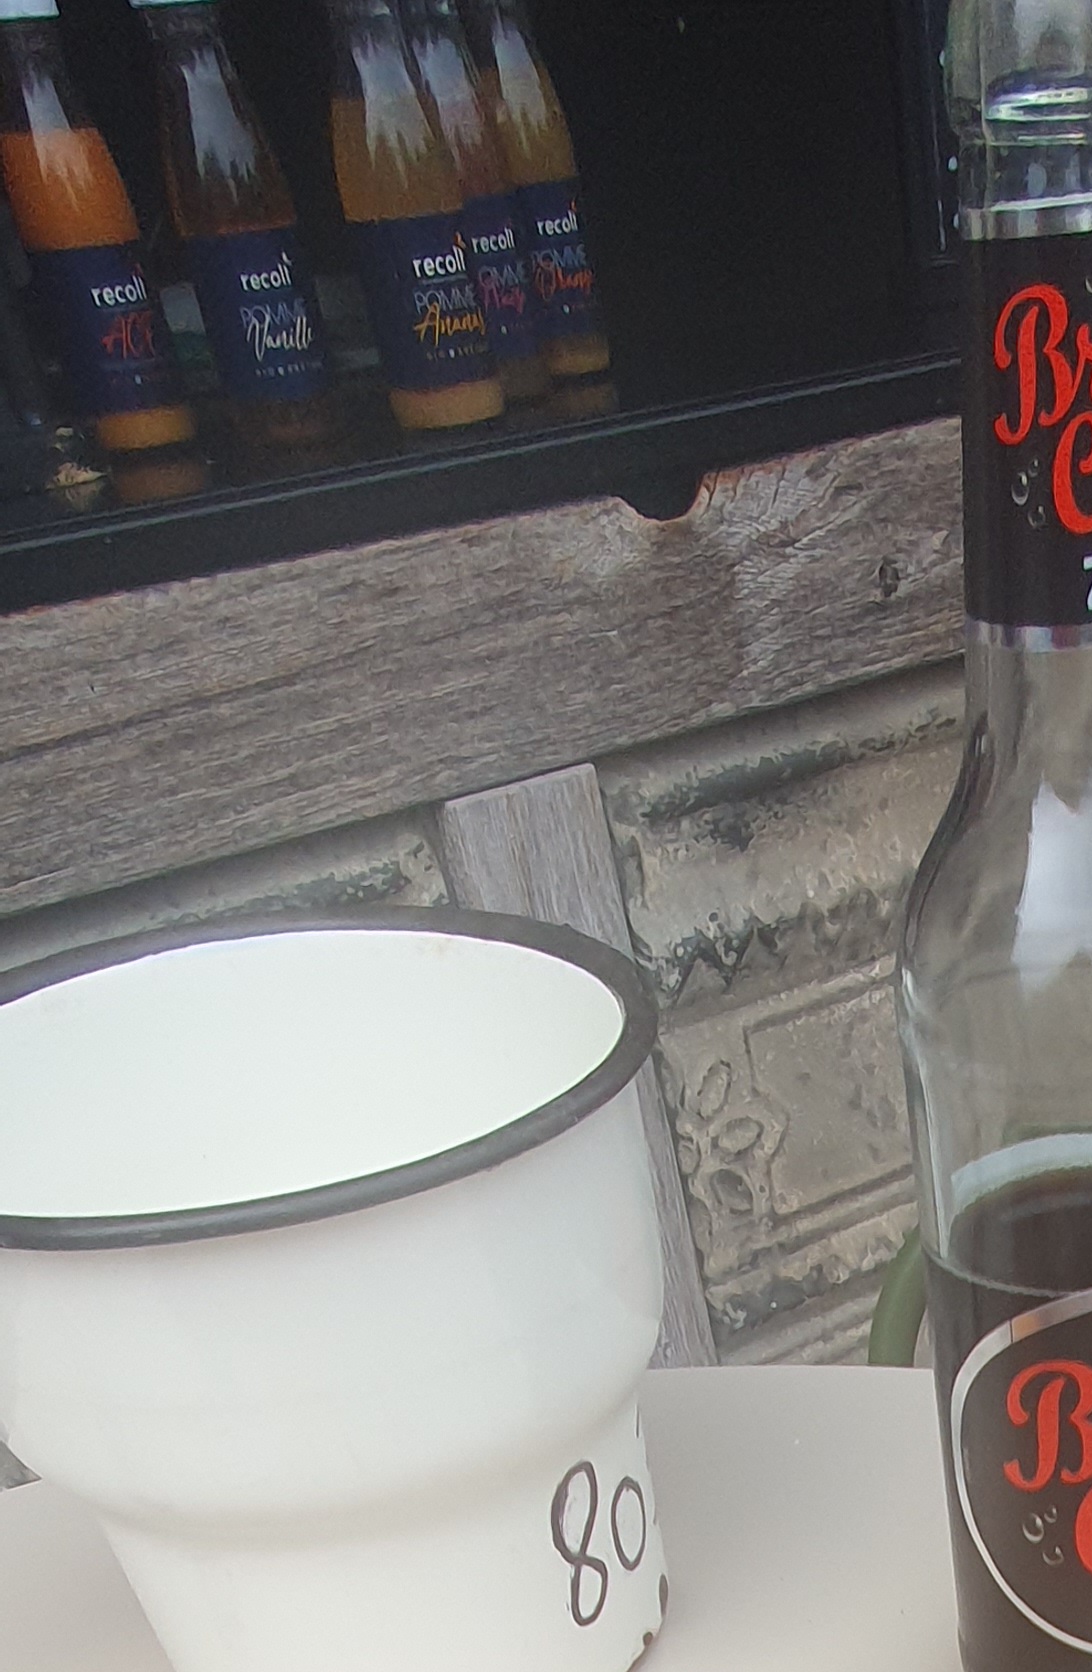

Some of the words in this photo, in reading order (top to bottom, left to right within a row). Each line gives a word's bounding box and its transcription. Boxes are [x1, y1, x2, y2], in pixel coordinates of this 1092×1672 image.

[537, 210, 578, 236] recoll
[471, 227, 516, 254] recoll
[412, 246, 466, 278] recoll
[91, 275, 147, 307] recoll
[240, 264, 292, 291] recoll
[550, 1460, 646, 1627] 80
